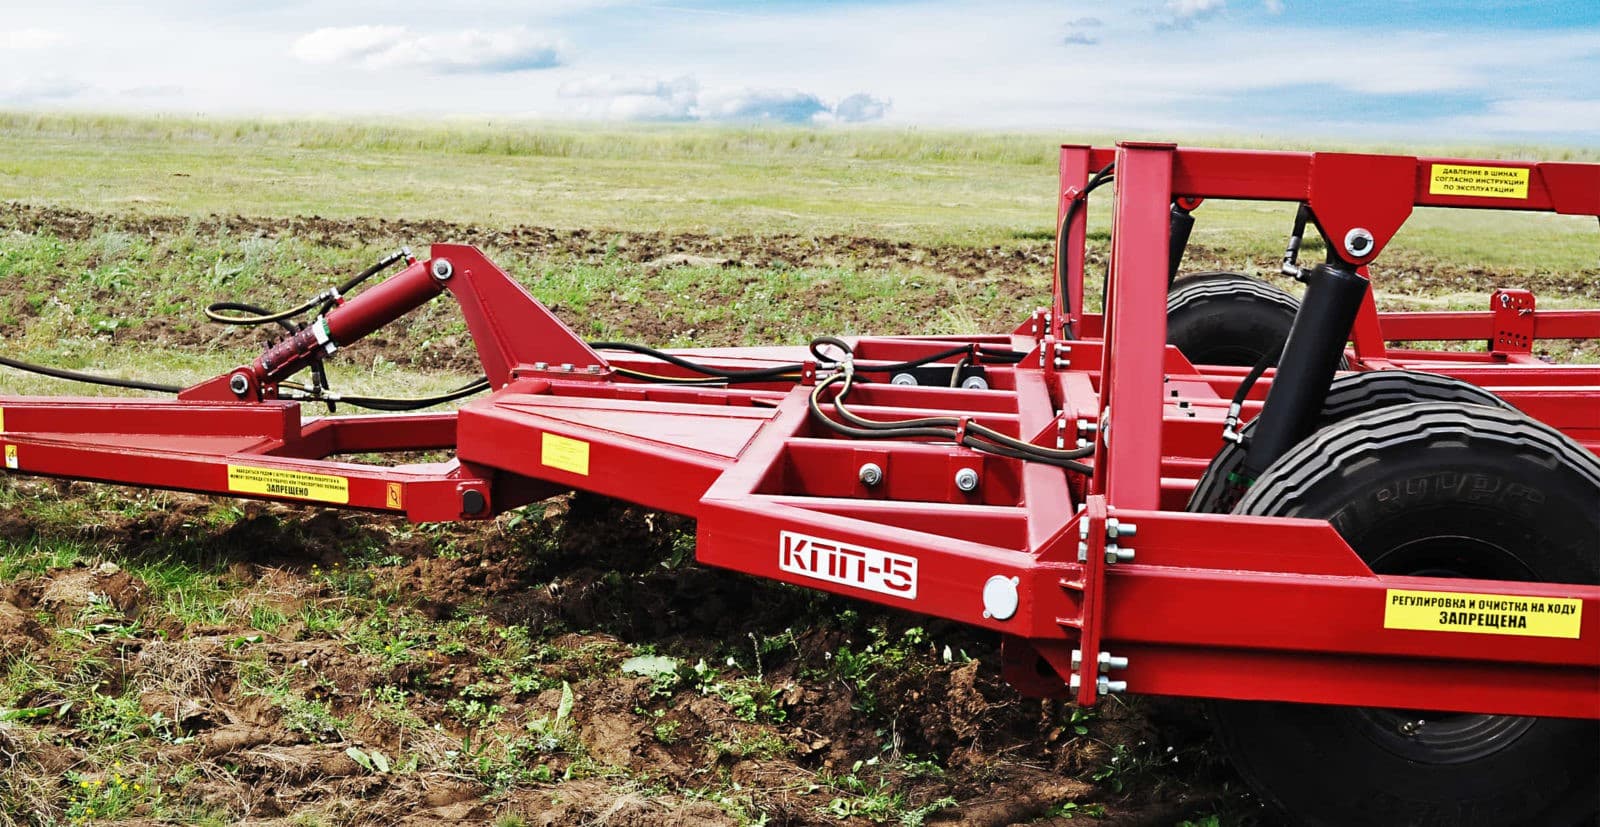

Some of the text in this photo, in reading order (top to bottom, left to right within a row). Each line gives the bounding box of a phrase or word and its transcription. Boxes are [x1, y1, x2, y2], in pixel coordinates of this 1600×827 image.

[1443, 168, 1482, 176] ДАВЛЕНИЕ
[1456, 185, 1515, 193] ЭКСПЛУАТАЦИИ
[266, 484, 308, 496] ЗАПРЕЩЕНО
[784, 536, 913, 592] КПП-5
[1392, 595, 1576, 615] РЕГУЛИРОВКА И ОЧИСТКА НА ХОДУ
[1439, 611, 1526, 629] ЗАПРЕЩЕНА
